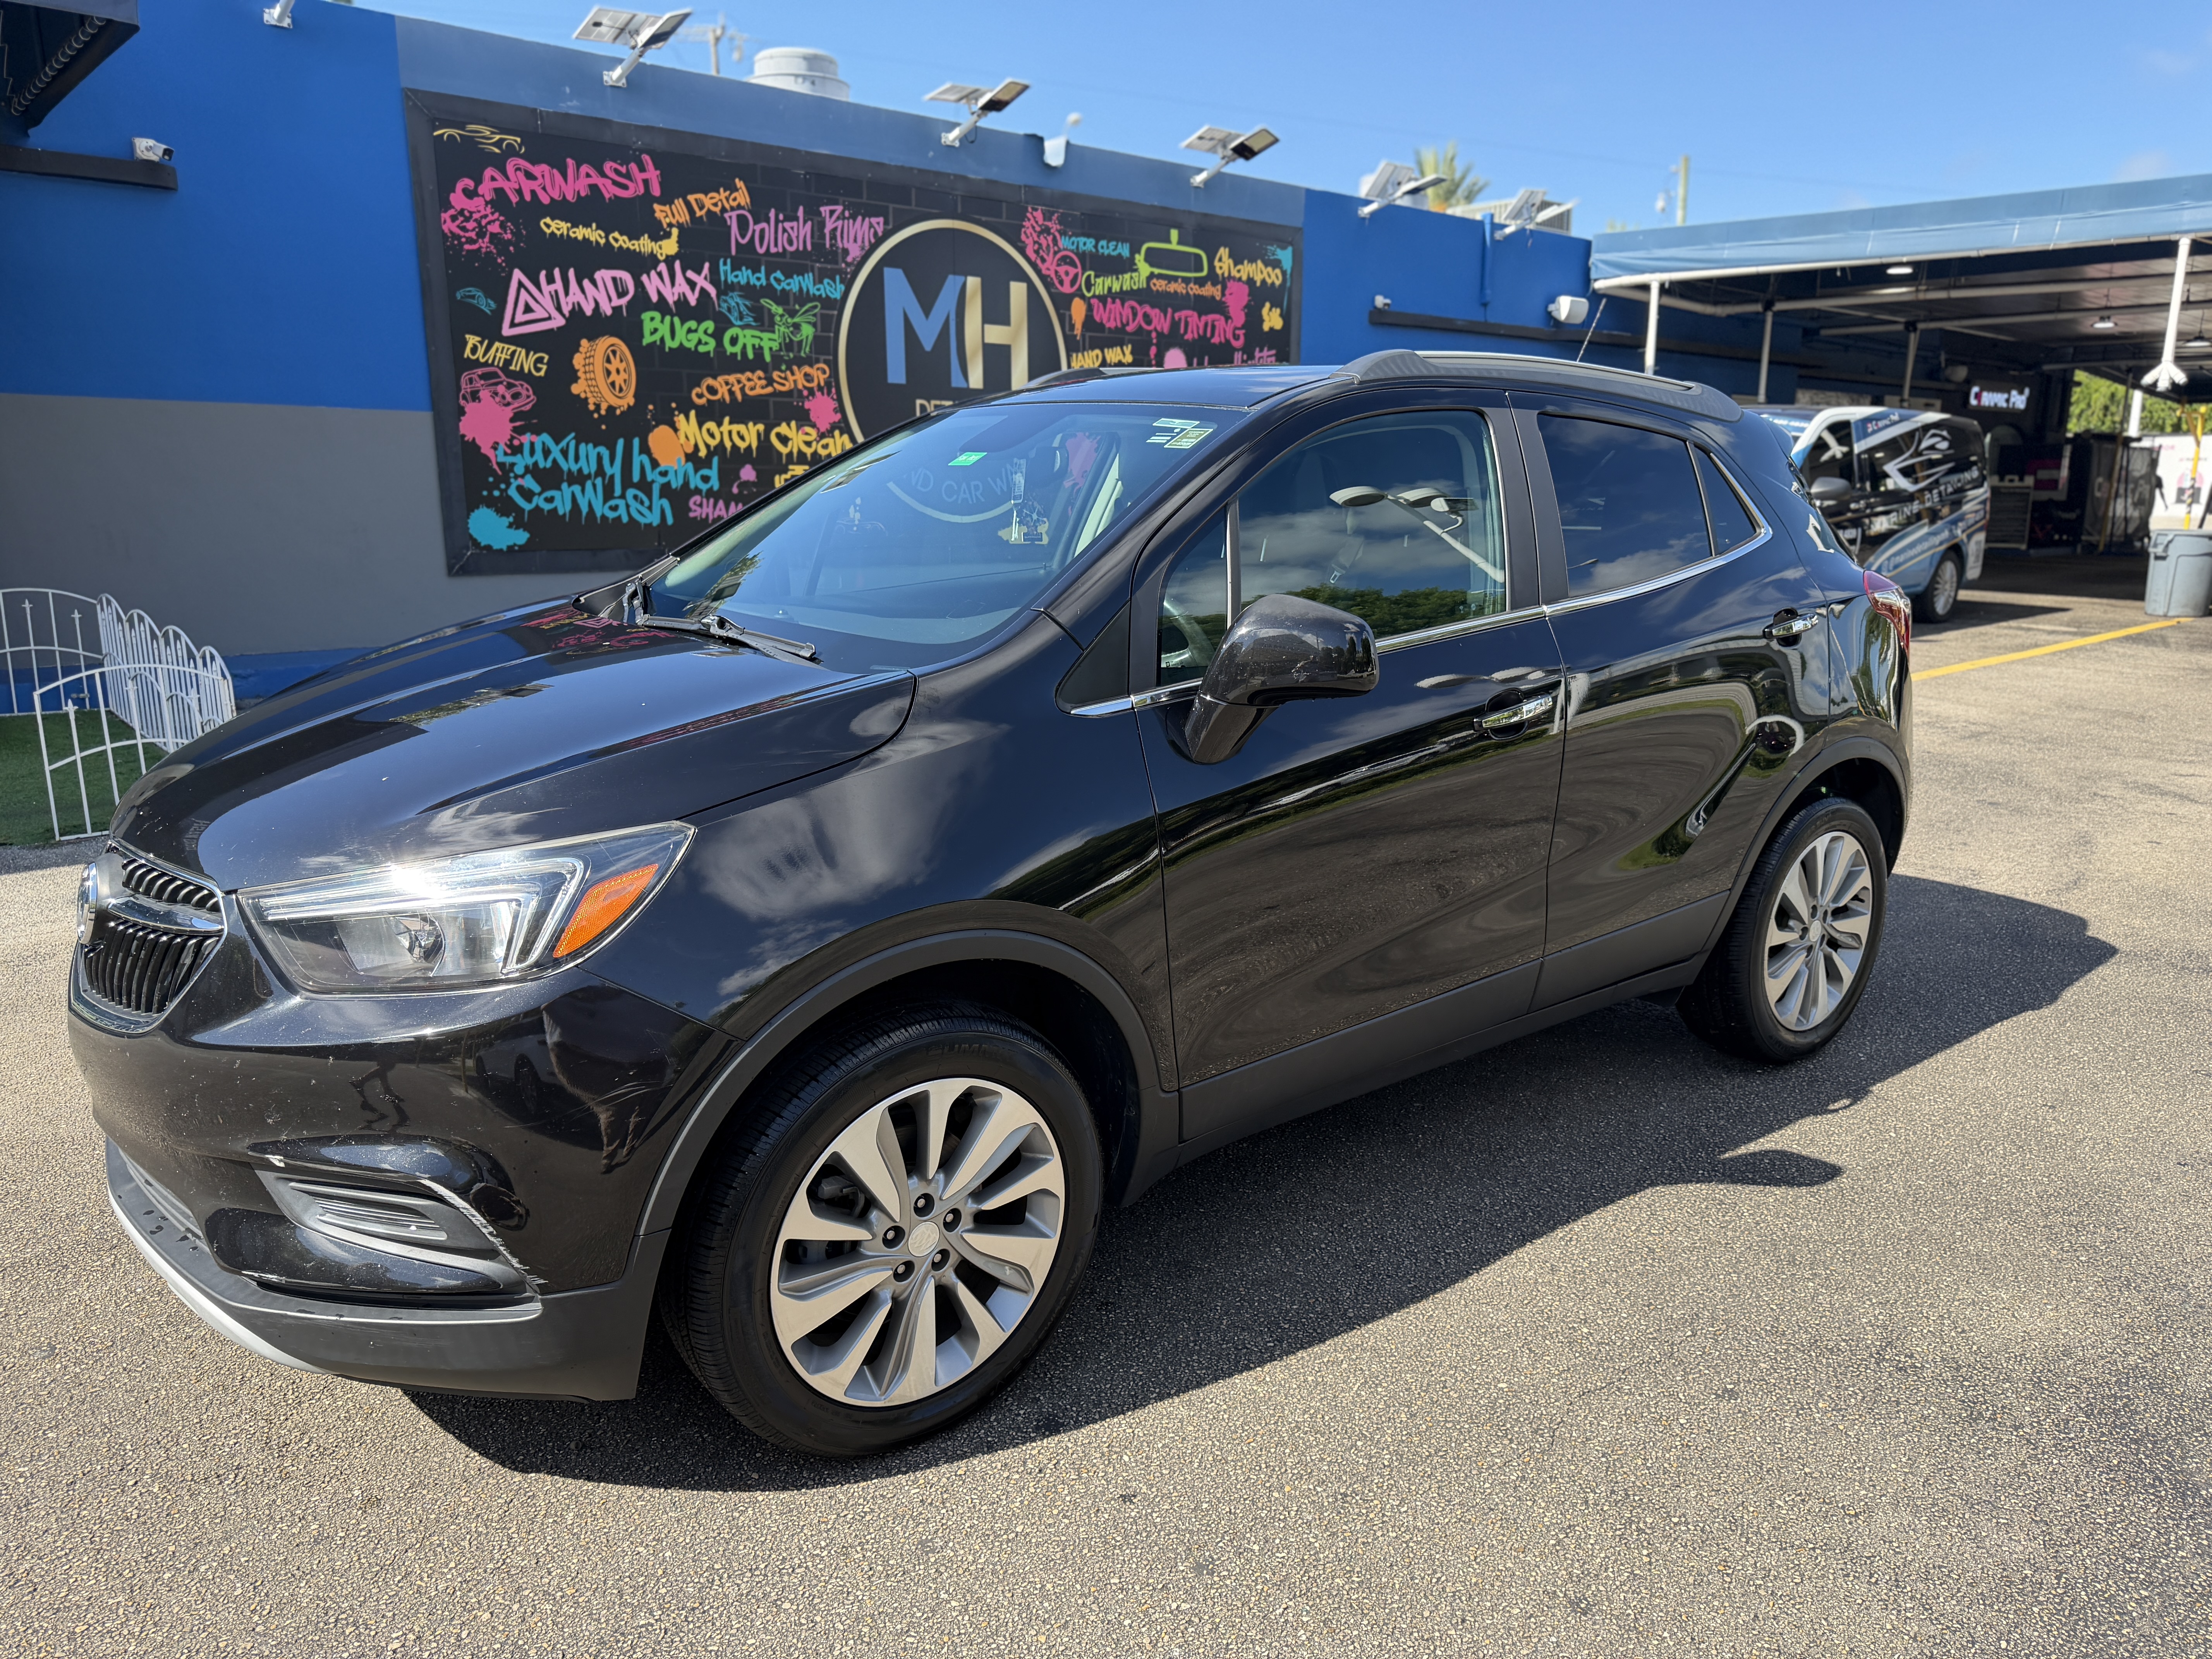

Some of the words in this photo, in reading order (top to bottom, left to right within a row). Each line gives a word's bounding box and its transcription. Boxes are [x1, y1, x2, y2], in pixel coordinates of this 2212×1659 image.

[653, 198, 690, 228] Full
[687, 178, 751, 221] Detail
[724, 206, 812, 255] Polish
[820, 206, 883, 248] Rims
[1061, 235, 1096, 253] MOTOR
[1097, 239, 1130, 259] CLEAN
[540, 268, 634, 316] HAND
[641, 260, 718, 312] WAX
[720, 258, 766, 289] Hand
[1214, 247, 1283, 287] Shampoo
[641, 311, 716, 357] BUGS
[723, 328, 779, 362] OFF
[884, 267, 1029, 391] MH
[1090, 298, 1172, 334] WINDOW
[1175, 310, 1246, 348] TINTING
[464, 334, 549, 377] BUFFING
[1104, 344, 1133, 366] WAX
[692, 370, 774, 407] COFFEE
[772, 363, 830, 392] SHOP
[678, 409, 764, 459] Motor
[771, 420, 853, 464] Clean
[496, 432, 624, 497] Luxury
[632, 436, 719, 496] hand
[942, 481, 985, 503] CAR
